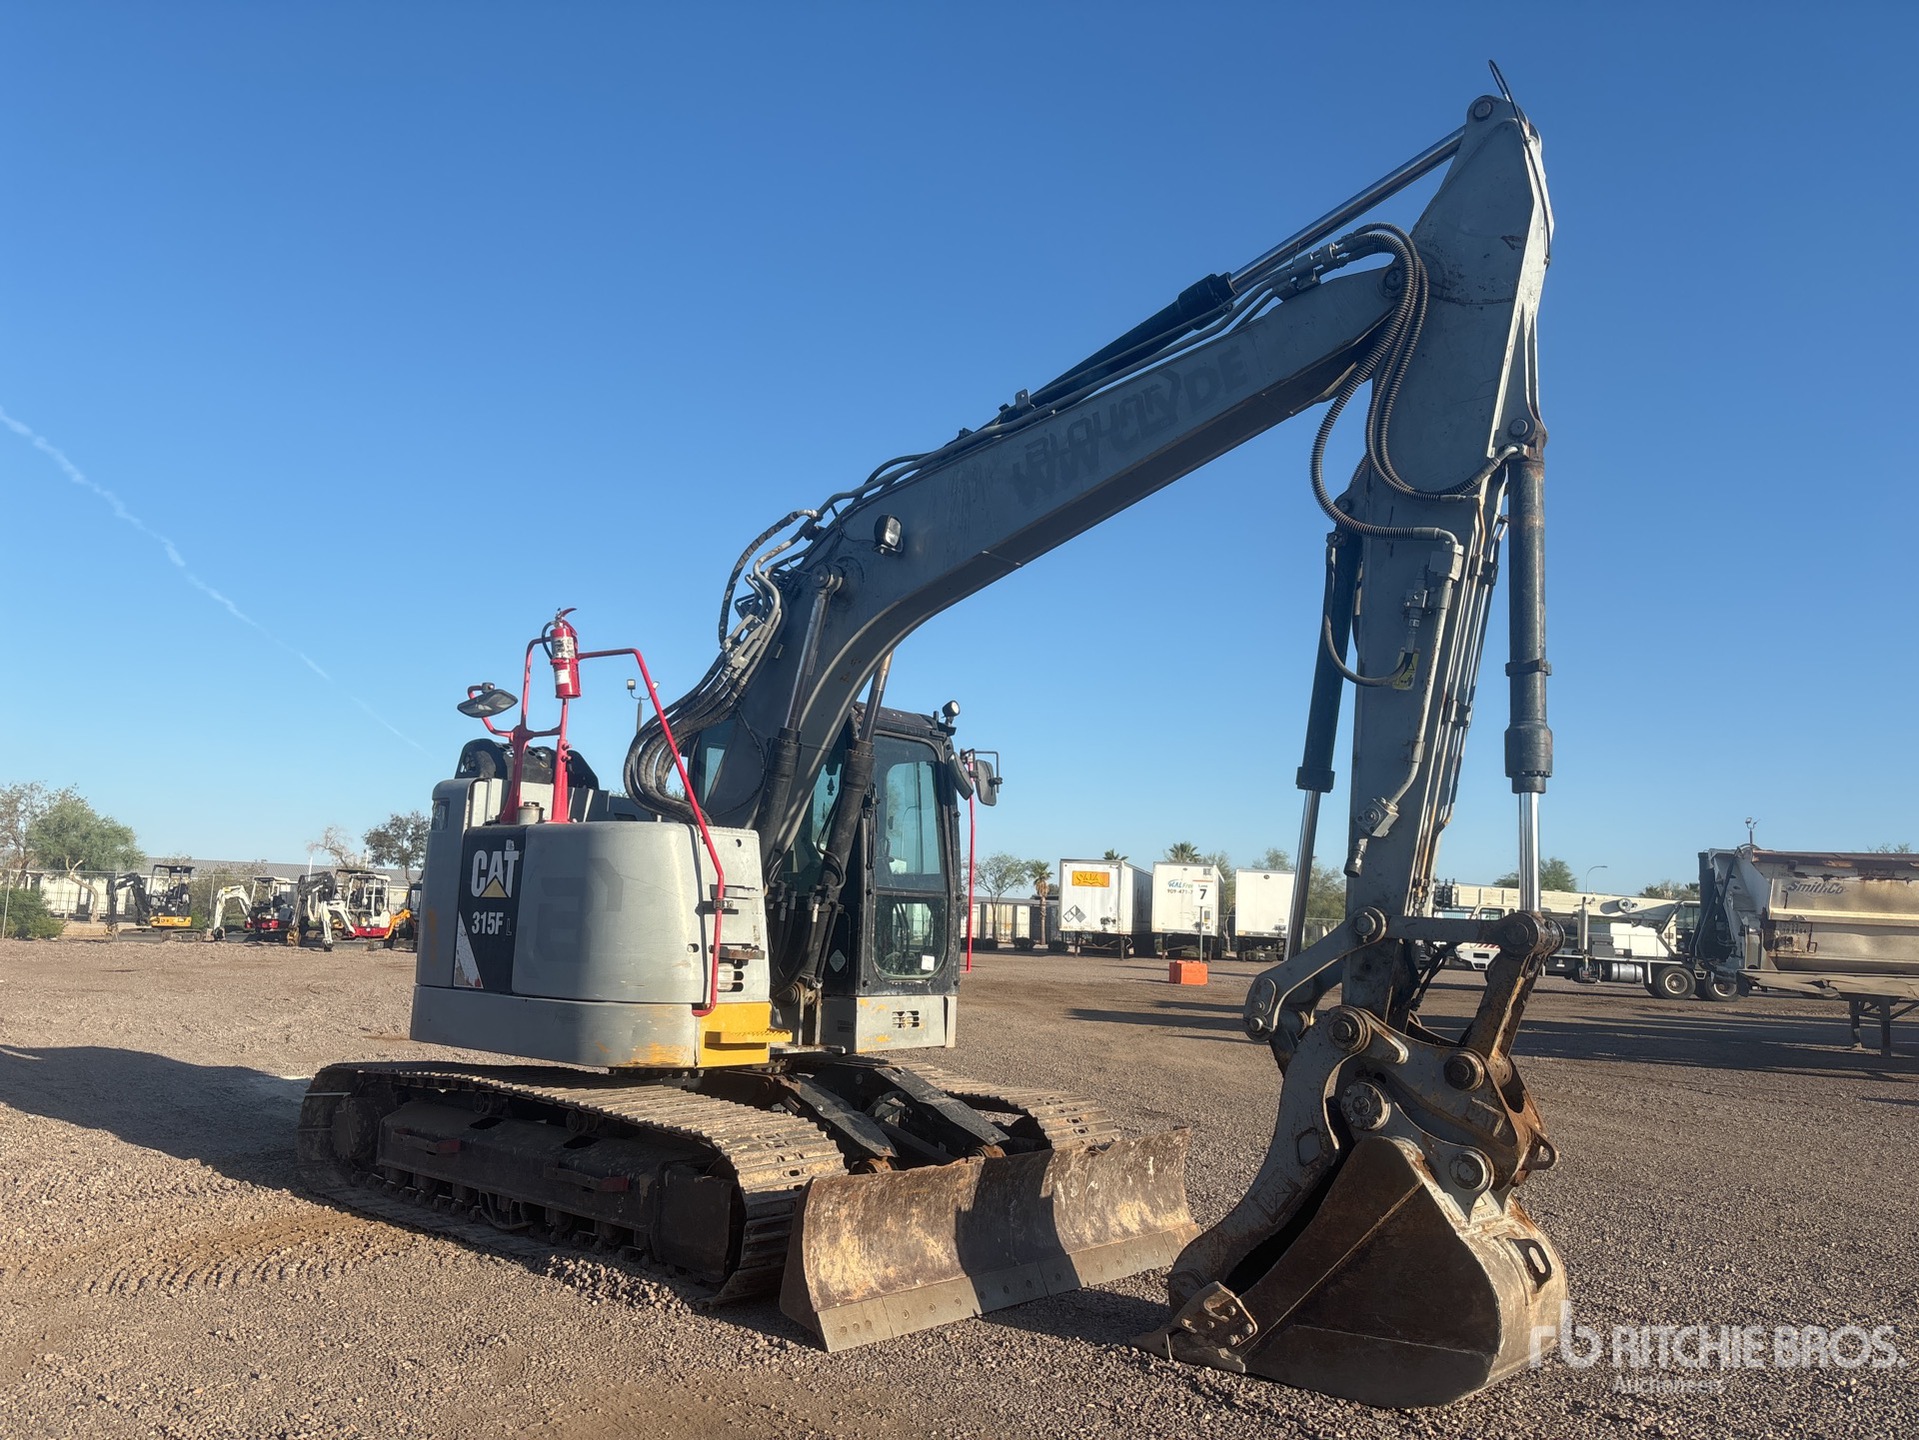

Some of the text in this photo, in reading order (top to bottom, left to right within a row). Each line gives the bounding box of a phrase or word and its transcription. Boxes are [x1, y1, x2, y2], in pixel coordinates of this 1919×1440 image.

[471, 850, 520, 898] CAT
[1199, 888, 1207, 900] 7
[471, 911, 504, 935] 315F
